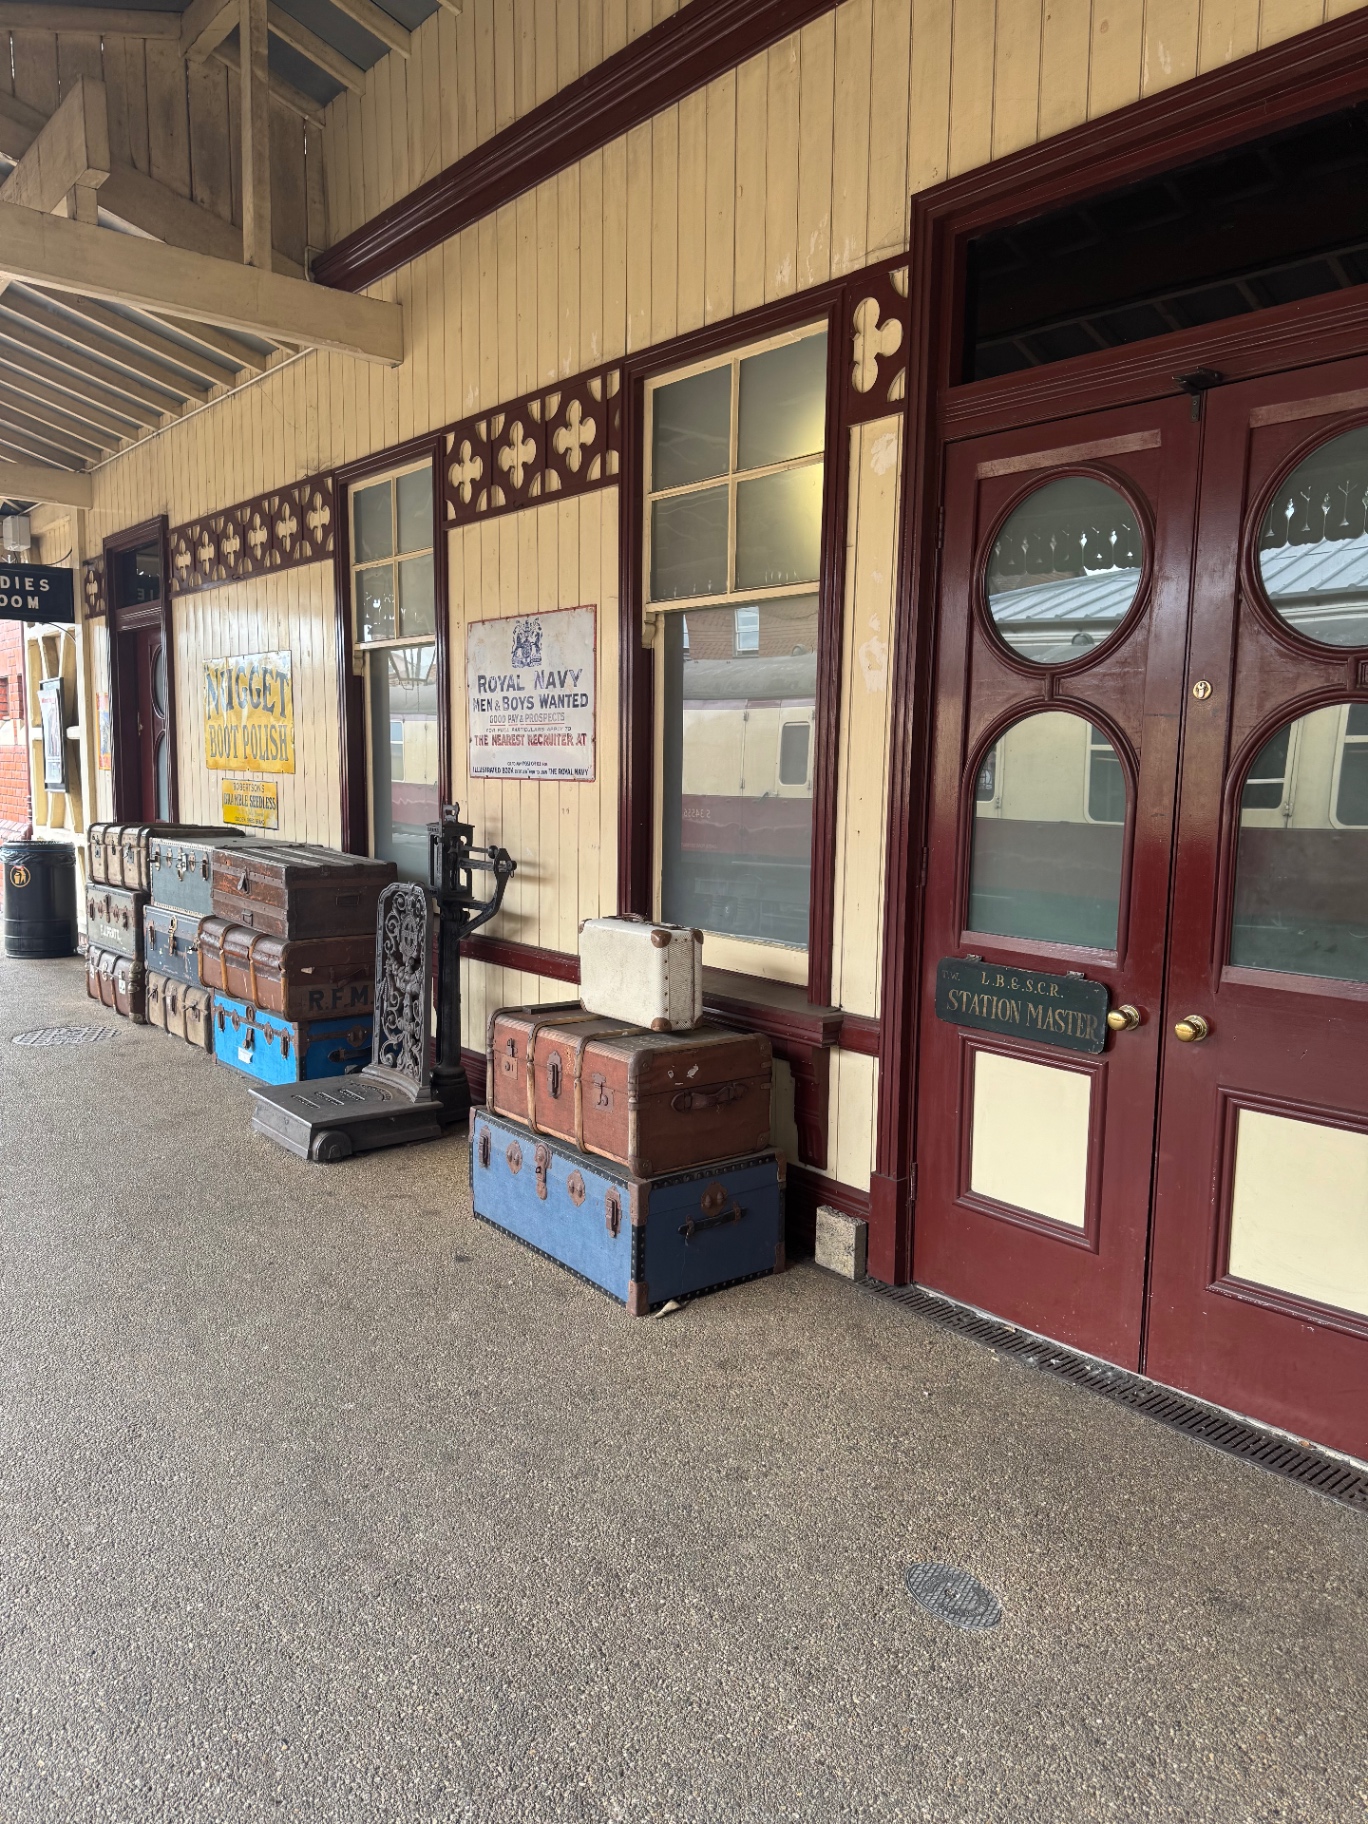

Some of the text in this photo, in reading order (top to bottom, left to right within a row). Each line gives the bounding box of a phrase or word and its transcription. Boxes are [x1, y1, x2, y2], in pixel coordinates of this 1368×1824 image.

[477, 668, 583, 695] ROYAL NAVY
[473, 692, 589, 712] MEN & BOYS WANTED
[489, 712, 565, 724] GOOD PAY & PROSPECTS
[208, 723, 289, 762] BOOT POLISH
[474, 733, 587, 746] THE NEAREST RECRUITER AT
[502, 766, 514, 774] BOOK
[946, 989, 1099, 1041] STATION MASTER
